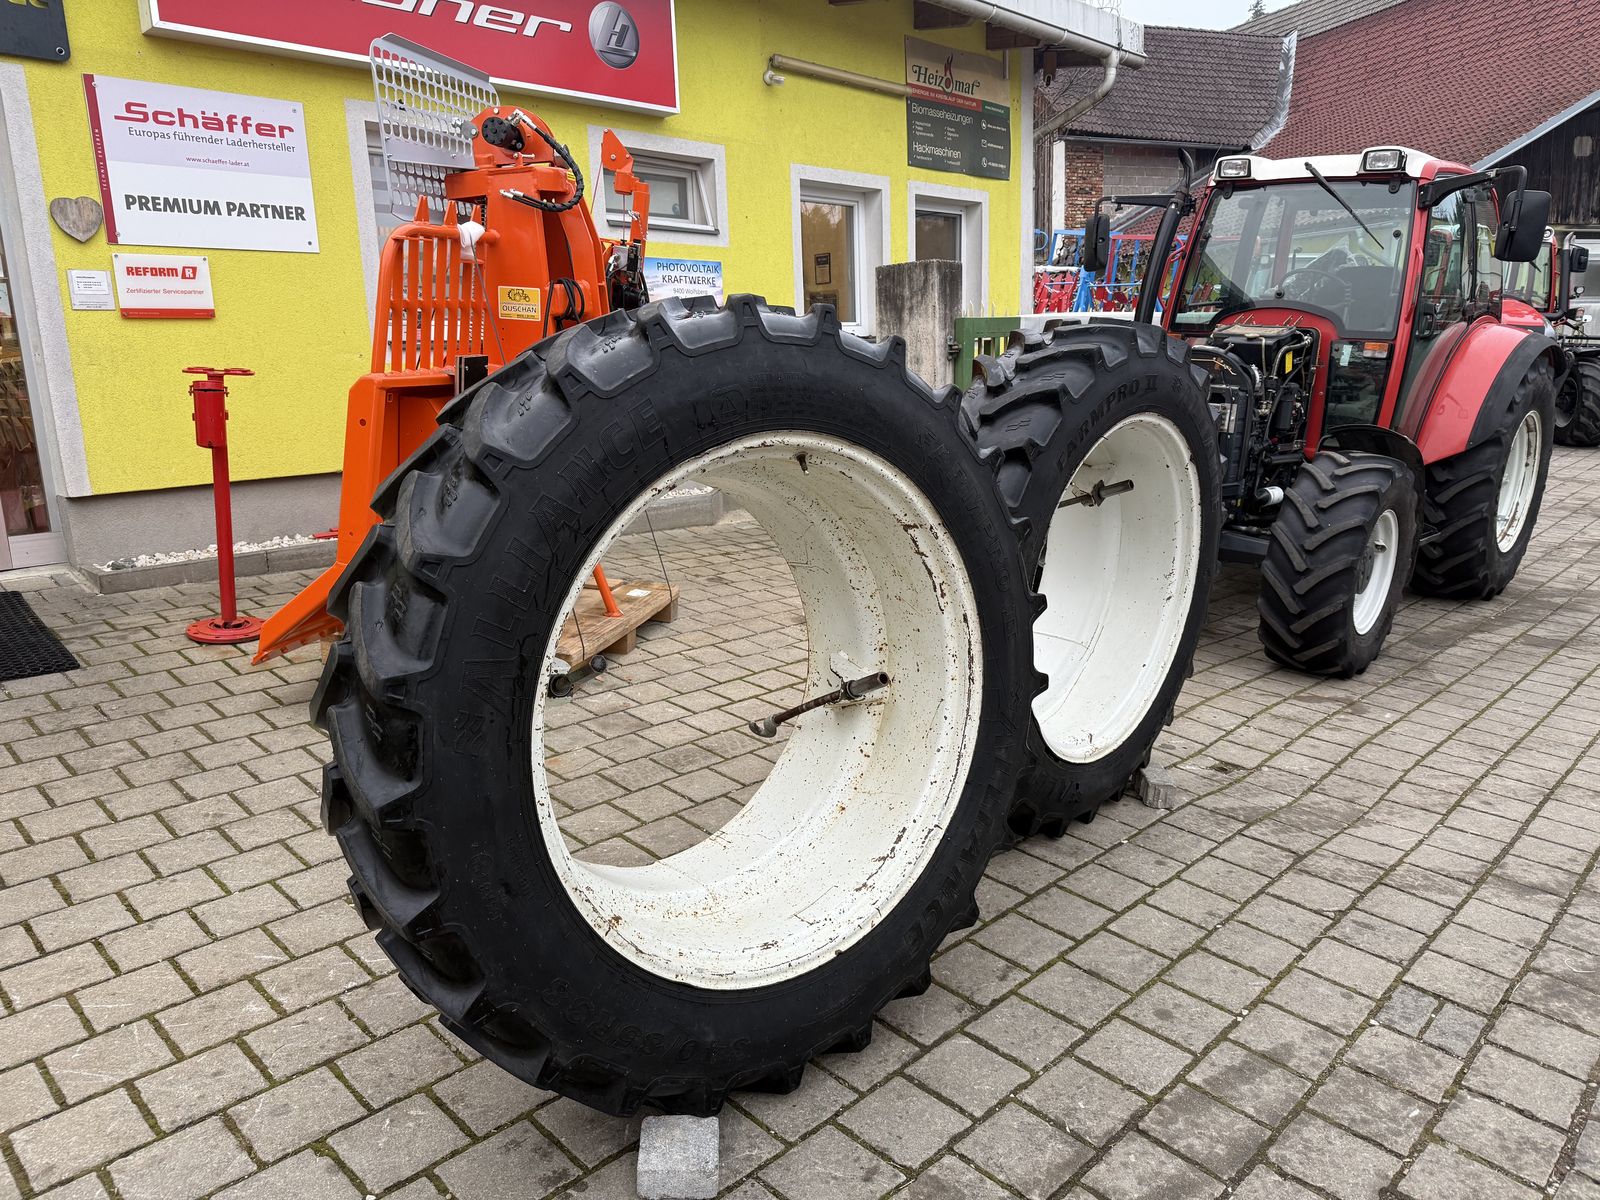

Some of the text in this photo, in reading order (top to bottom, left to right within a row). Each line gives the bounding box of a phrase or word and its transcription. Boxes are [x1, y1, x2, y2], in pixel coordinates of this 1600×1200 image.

[114, 101, 295, 139] Schäffer
[911, 103, 974, 126] Biomasseheizungen
[128, 126, 296, 153] Europas führender Laderhersteller
[912, 141, 962, 159] Hackmaschinen
[186, 156, 250, 168] www.schaeffer-lader.at
[124, 194, 307, 222] PREMIUM PARTNER
[126, 266, 179, 278] REFORM
[656, 262, 720, 274] PHOTOVOLTAIK
[662, 274, 716, 286] KRAFTWERKE
[126, 287, 204, 296] Zertifizierter Servicepartner
[673, 287, 685, 295] 9400
[502, 304, 537, 314] OUSCHAN
[459, 397, 666, 720] ALLIANCE
